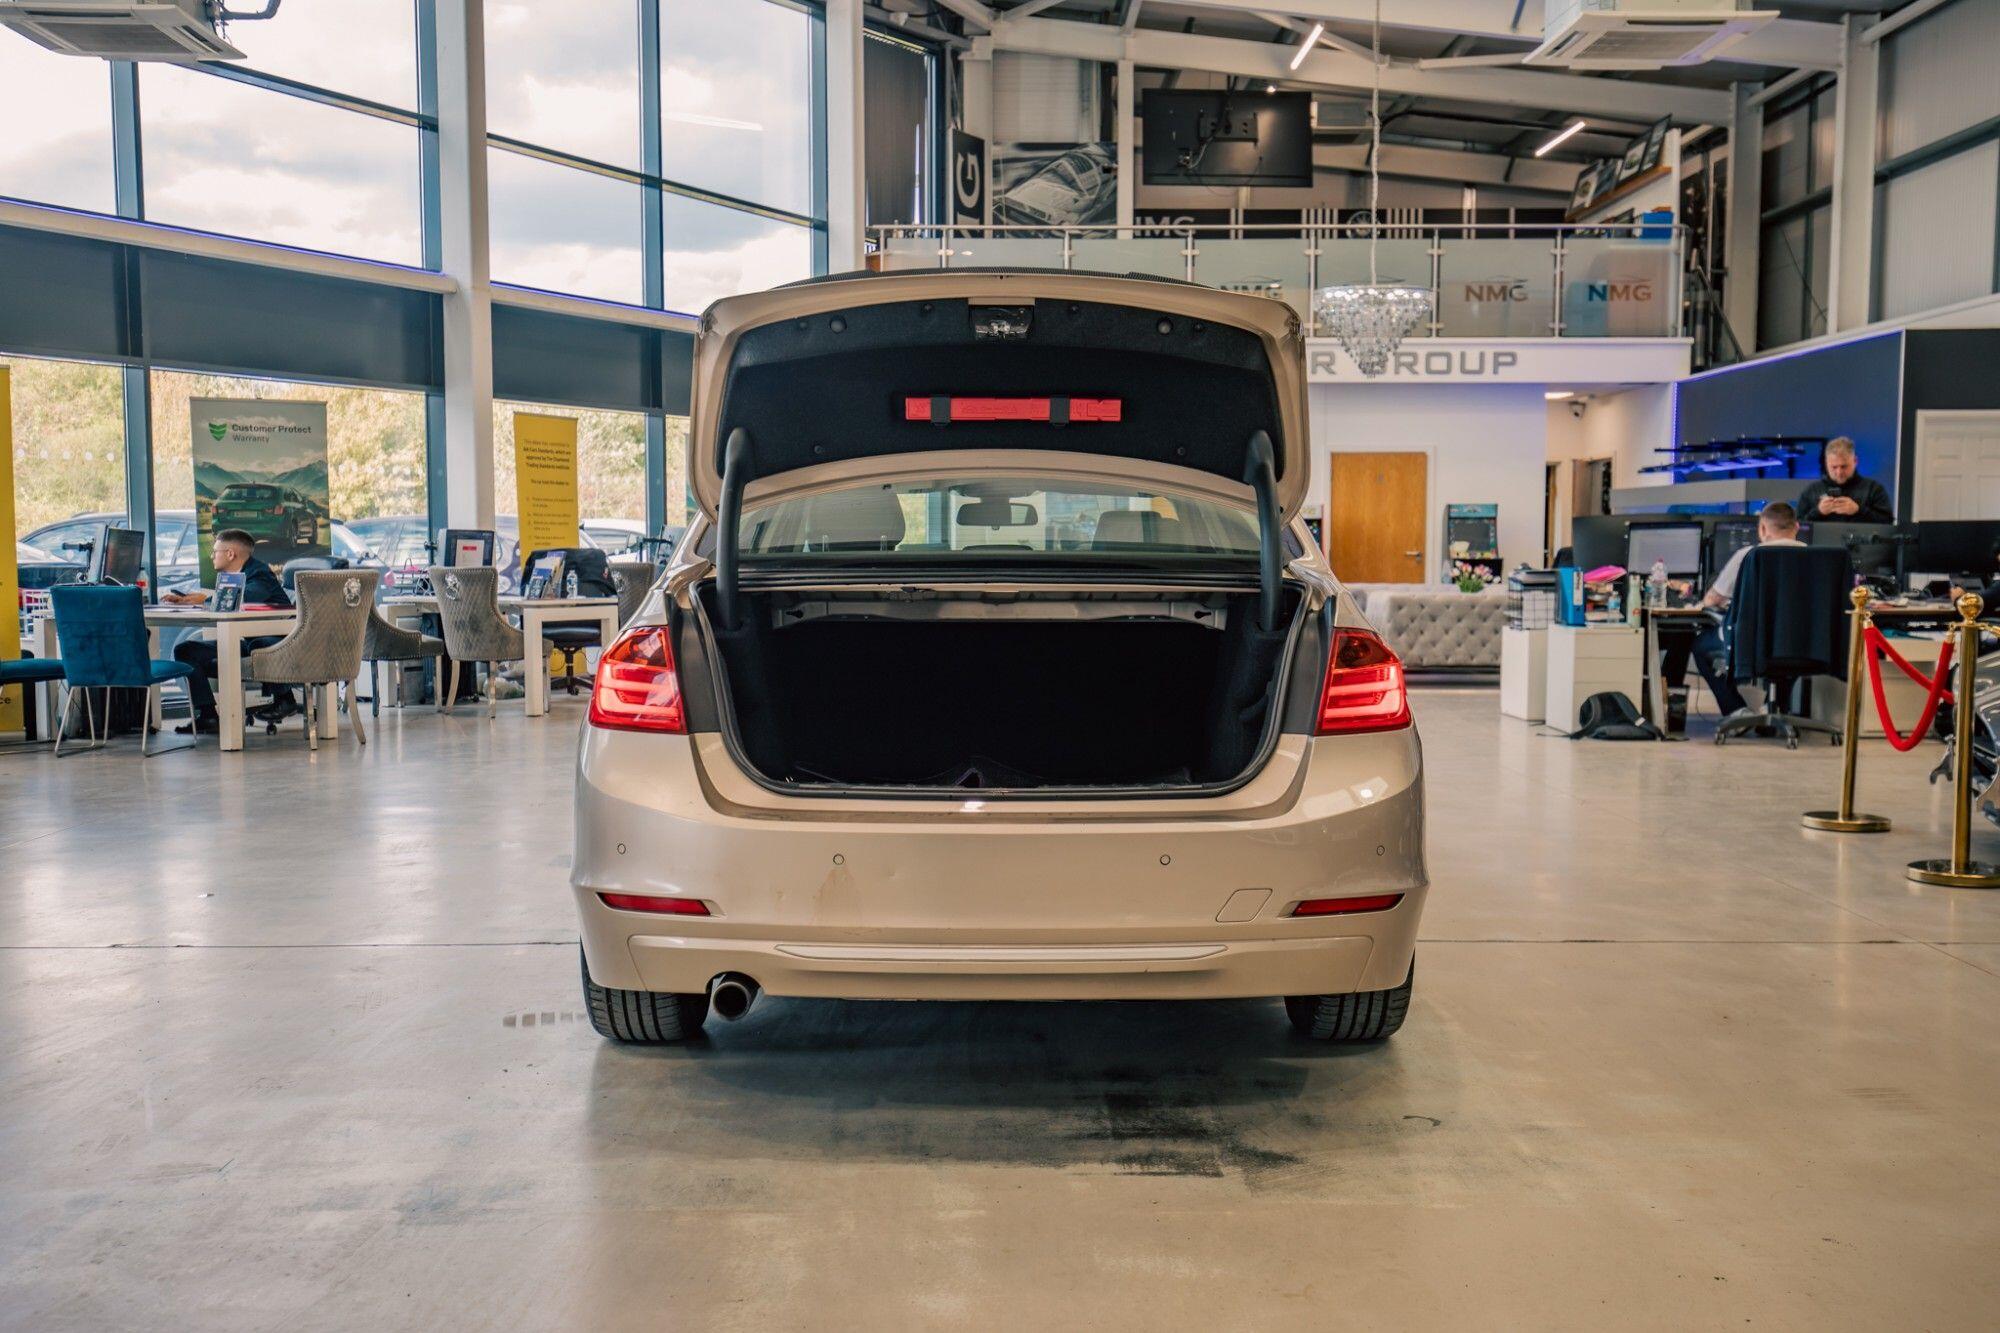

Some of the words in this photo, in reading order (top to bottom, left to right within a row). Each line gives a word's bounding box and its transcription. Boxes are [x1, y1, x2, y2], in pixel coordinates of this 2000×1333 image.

[1465, 285, 1528, 302] NMG
[1588, 284, 1651, 302] NMG
[231, 423, 276, 433] Customer
[278, 425, 312, 434] Protect
[232, 434, 270, 443] Warranty
